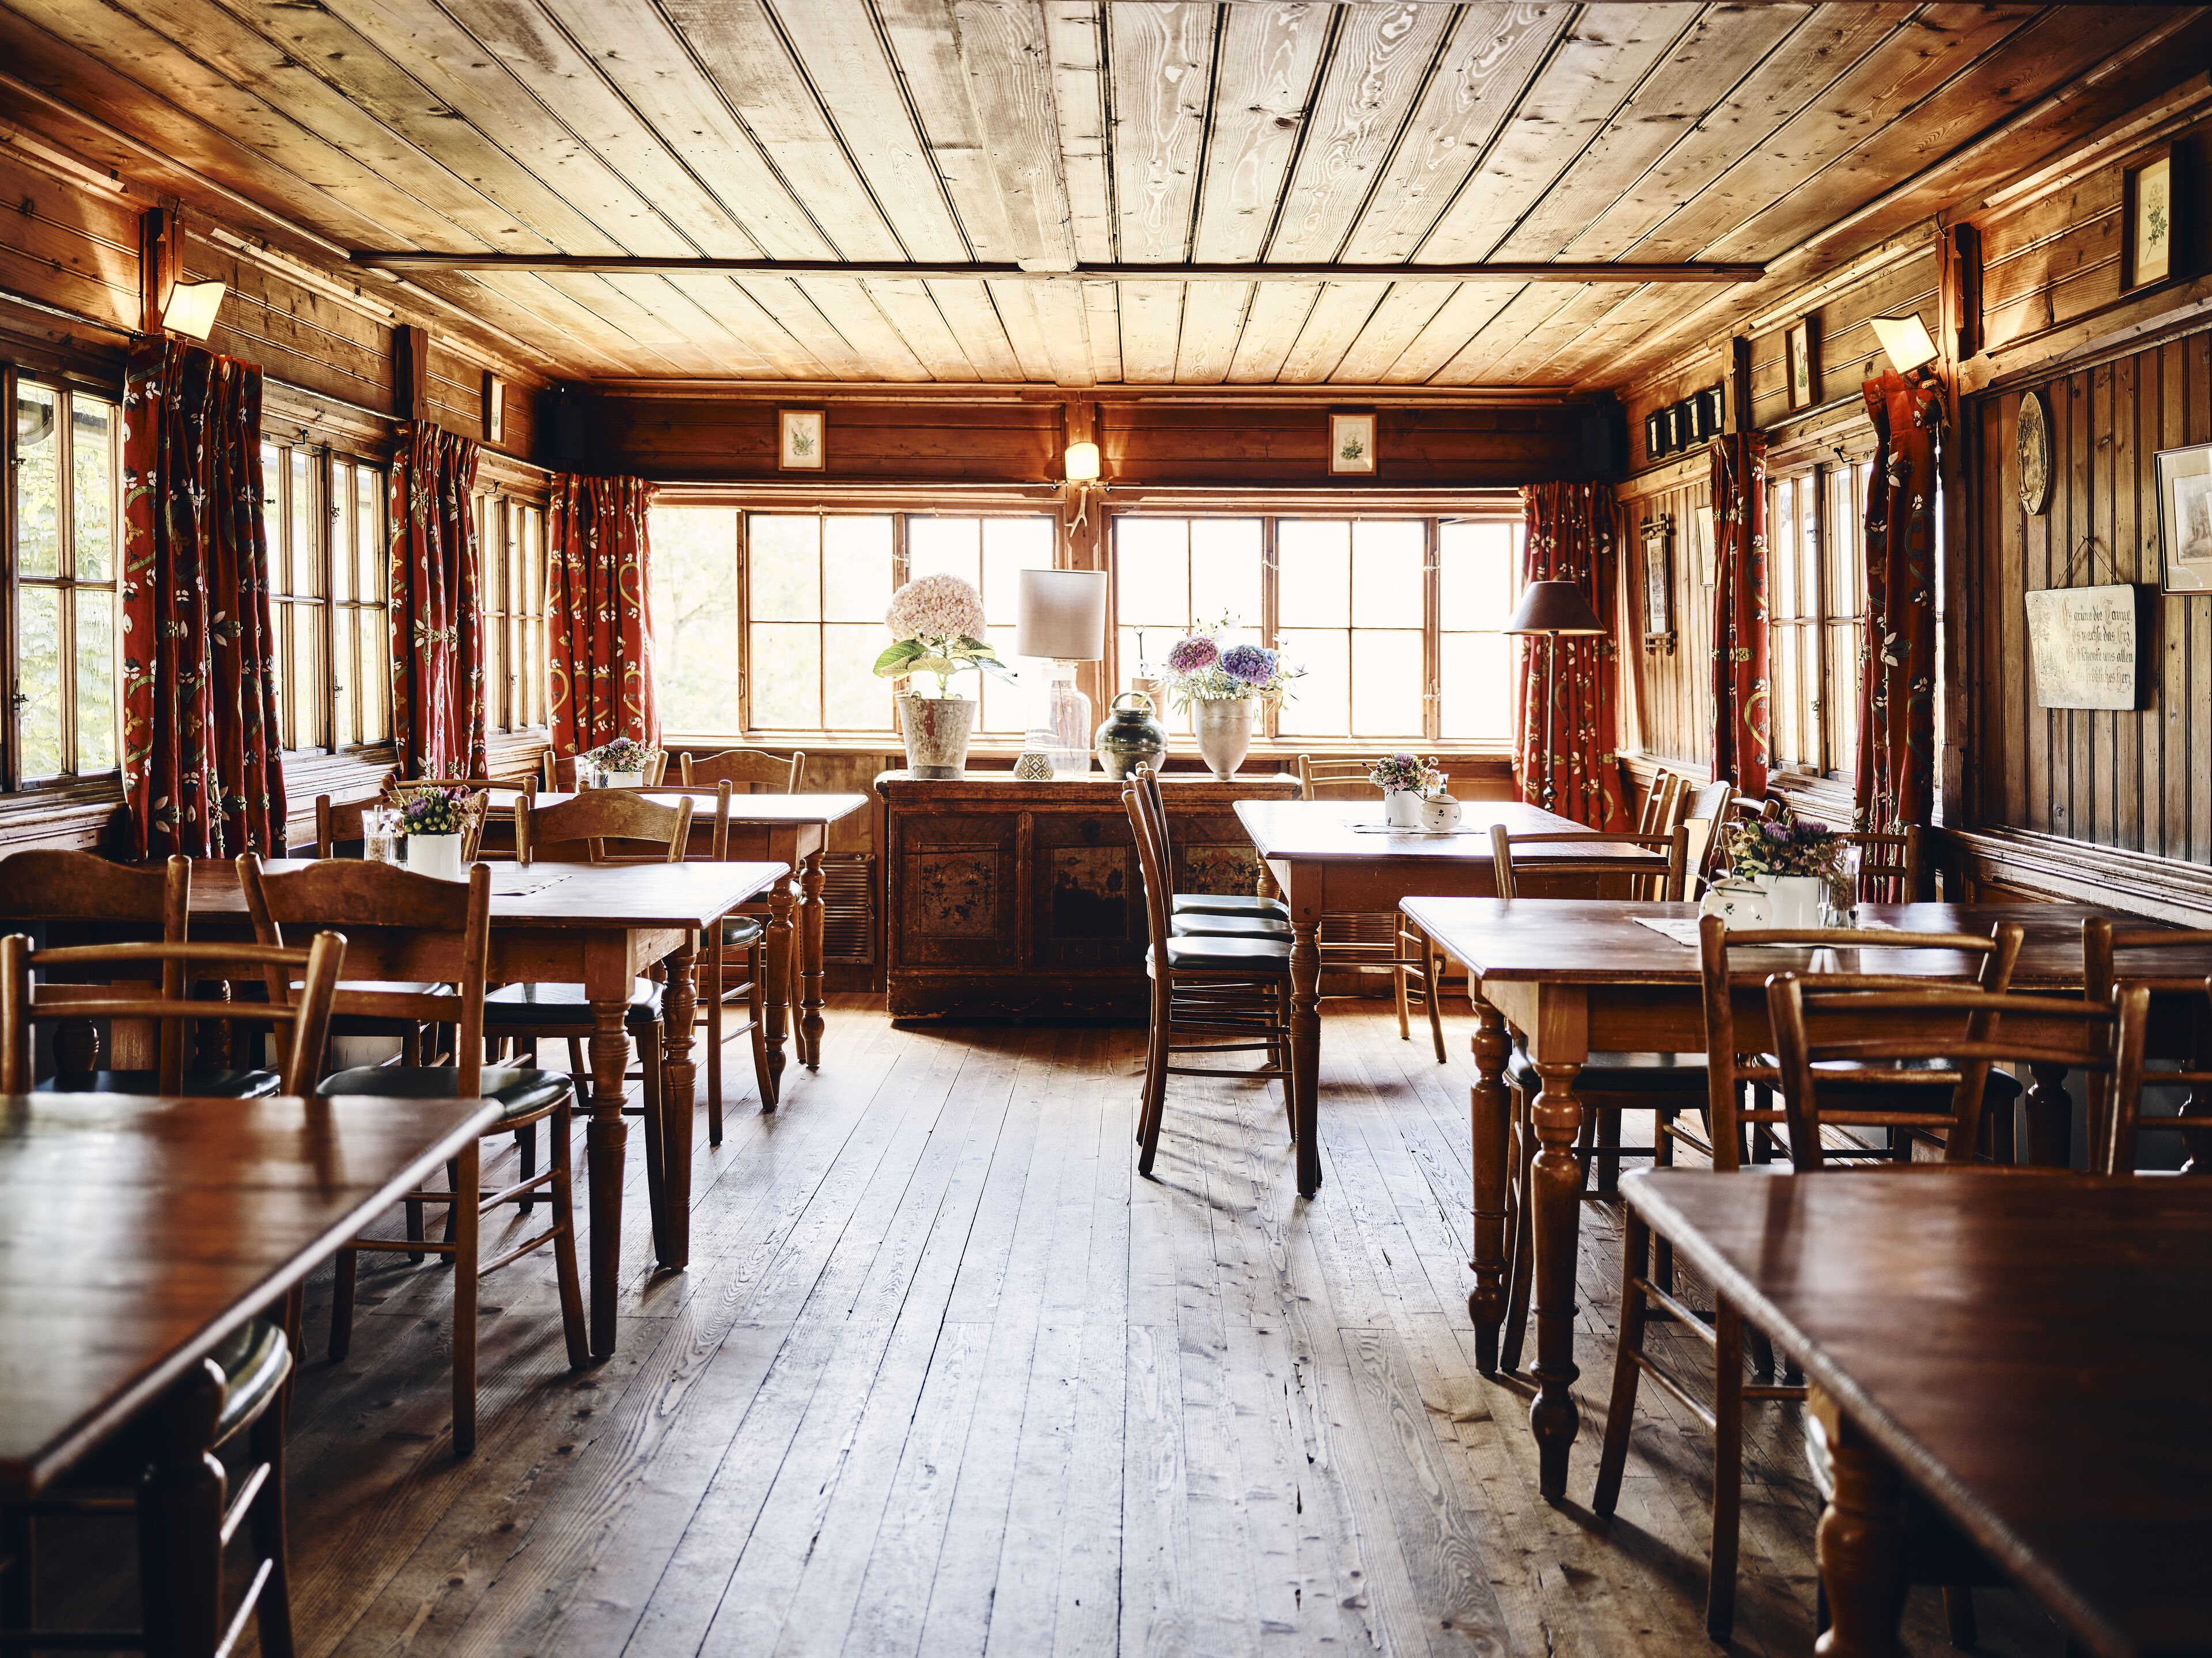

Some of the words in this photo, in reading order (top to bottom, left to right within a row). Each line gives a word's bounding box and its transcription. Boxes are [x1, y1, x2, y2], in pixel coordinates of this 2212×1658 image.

[2074, 604, 2092, 625] grüne
[2092, 604, 2103, 621] die
[2103, 624, 2116, 644] das
[2103, 652, 2116, 663] uns
[2116, 646, 2133, 663] allen
